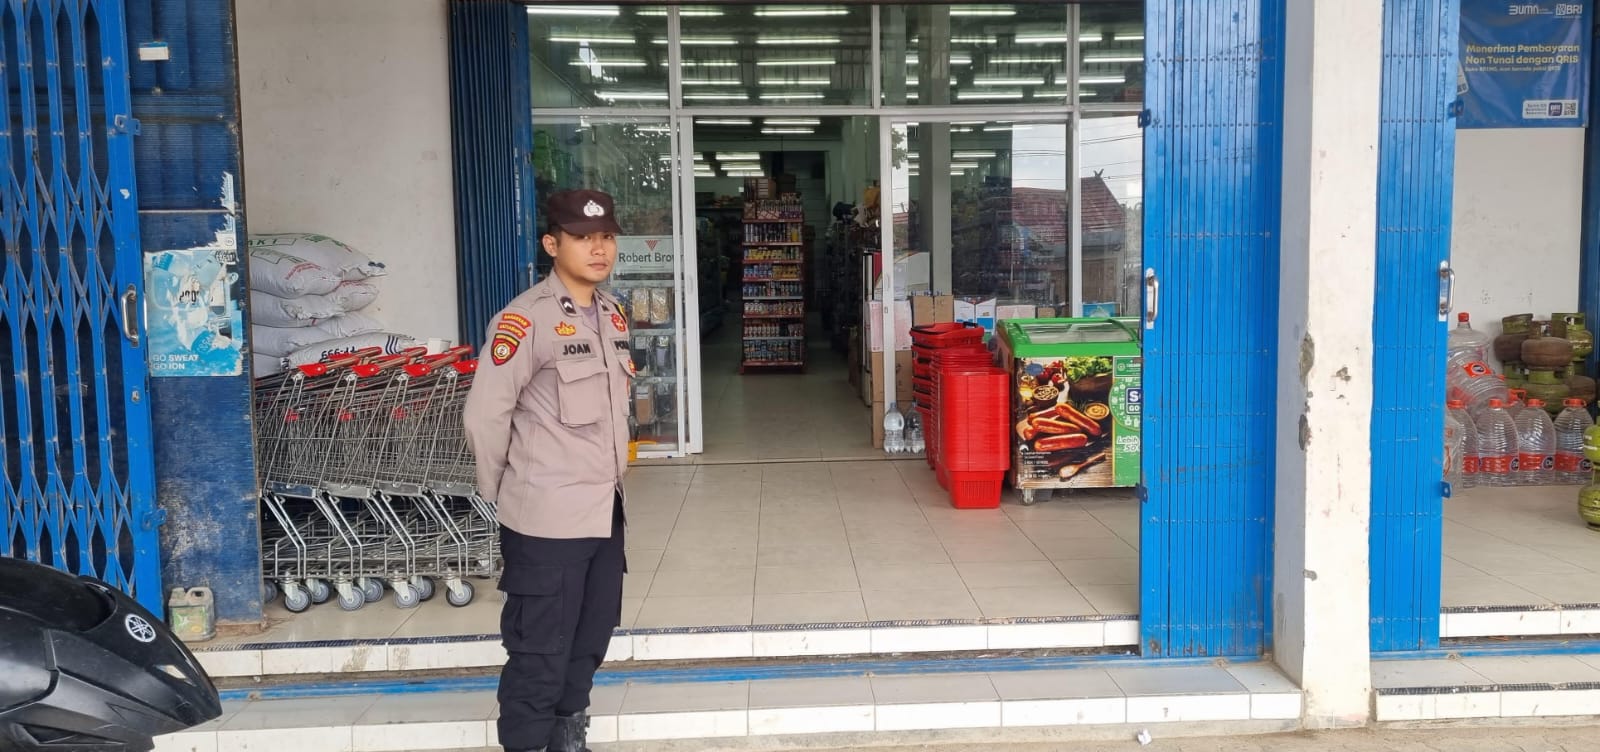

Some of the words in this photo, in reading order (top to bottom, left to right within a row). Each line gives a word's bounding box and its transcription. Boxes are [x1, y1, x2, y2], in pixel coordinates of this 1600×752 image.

[1566, 4, 1583, 15] BRI
[1466, 44, 1516, 53] Menerima
[1518, 44, 1580, 54] Pembayaran
[1466, 56, 1485, 65] Non
[1487, 56, 1514, 64] Tunai
[1516, 55, 1554, 66] dengan
[1556, 55, 1579, 65] QRIS
[618, 252, 651, 263] Robert
[563, 343, 591, 356] JOAN
[152, 354, 167, 362] GO
[168, 354, 199, 362] SWEAT
[153, 363, 167, 371] GO
